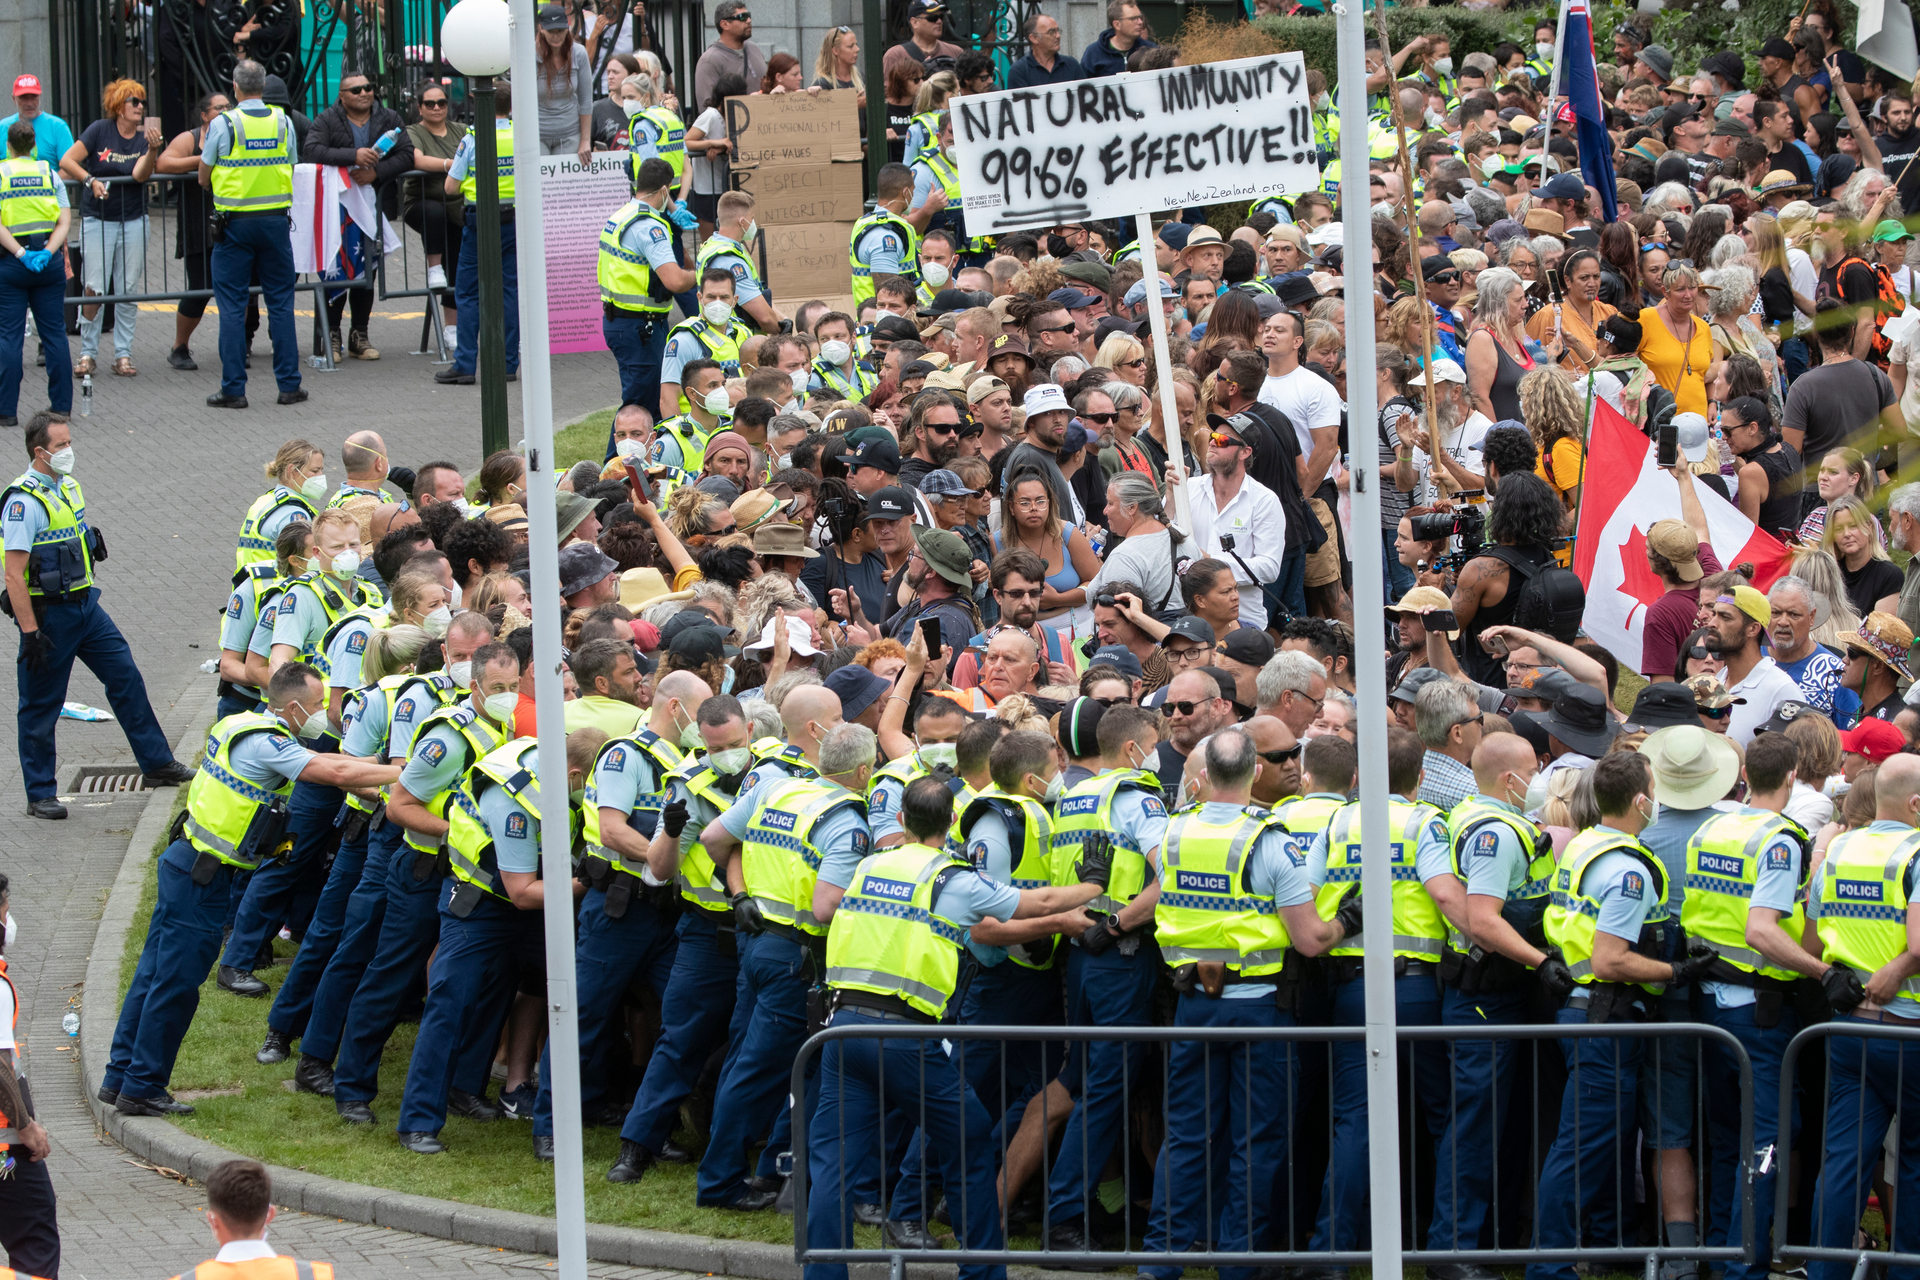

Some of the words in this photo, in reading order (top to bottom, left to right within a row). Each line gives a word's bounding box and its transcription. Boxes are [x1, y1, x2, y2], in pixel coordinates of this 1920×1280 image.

[960, 82, 1144, 142] NATURAL
[1158, 60, 1301, 115] IMMUNITY
[248, 140, 276, 148] POLICE
[1099, 105, 1317, 185] EFFECTIVE!!
[541, 163, 556, 177] ey
[12, 178, 42, 187] POLICE
[796, 253, 838, 269] TREATY
[828, 417, 848, 433] LW
[420, 754, 436, 767] POLICE
[1061, 799, 1095, 813] POLICE
[761, 811, 794, 828] POLICE
[1293, 836, 1312, 847] POL
[1700, 855, 1740, 873] POLICE
[865, 881, 911, 898] POLICE
[1180, 874, 1227, 890] POLICE
[1838, 883, 1880, 897] POLICE
